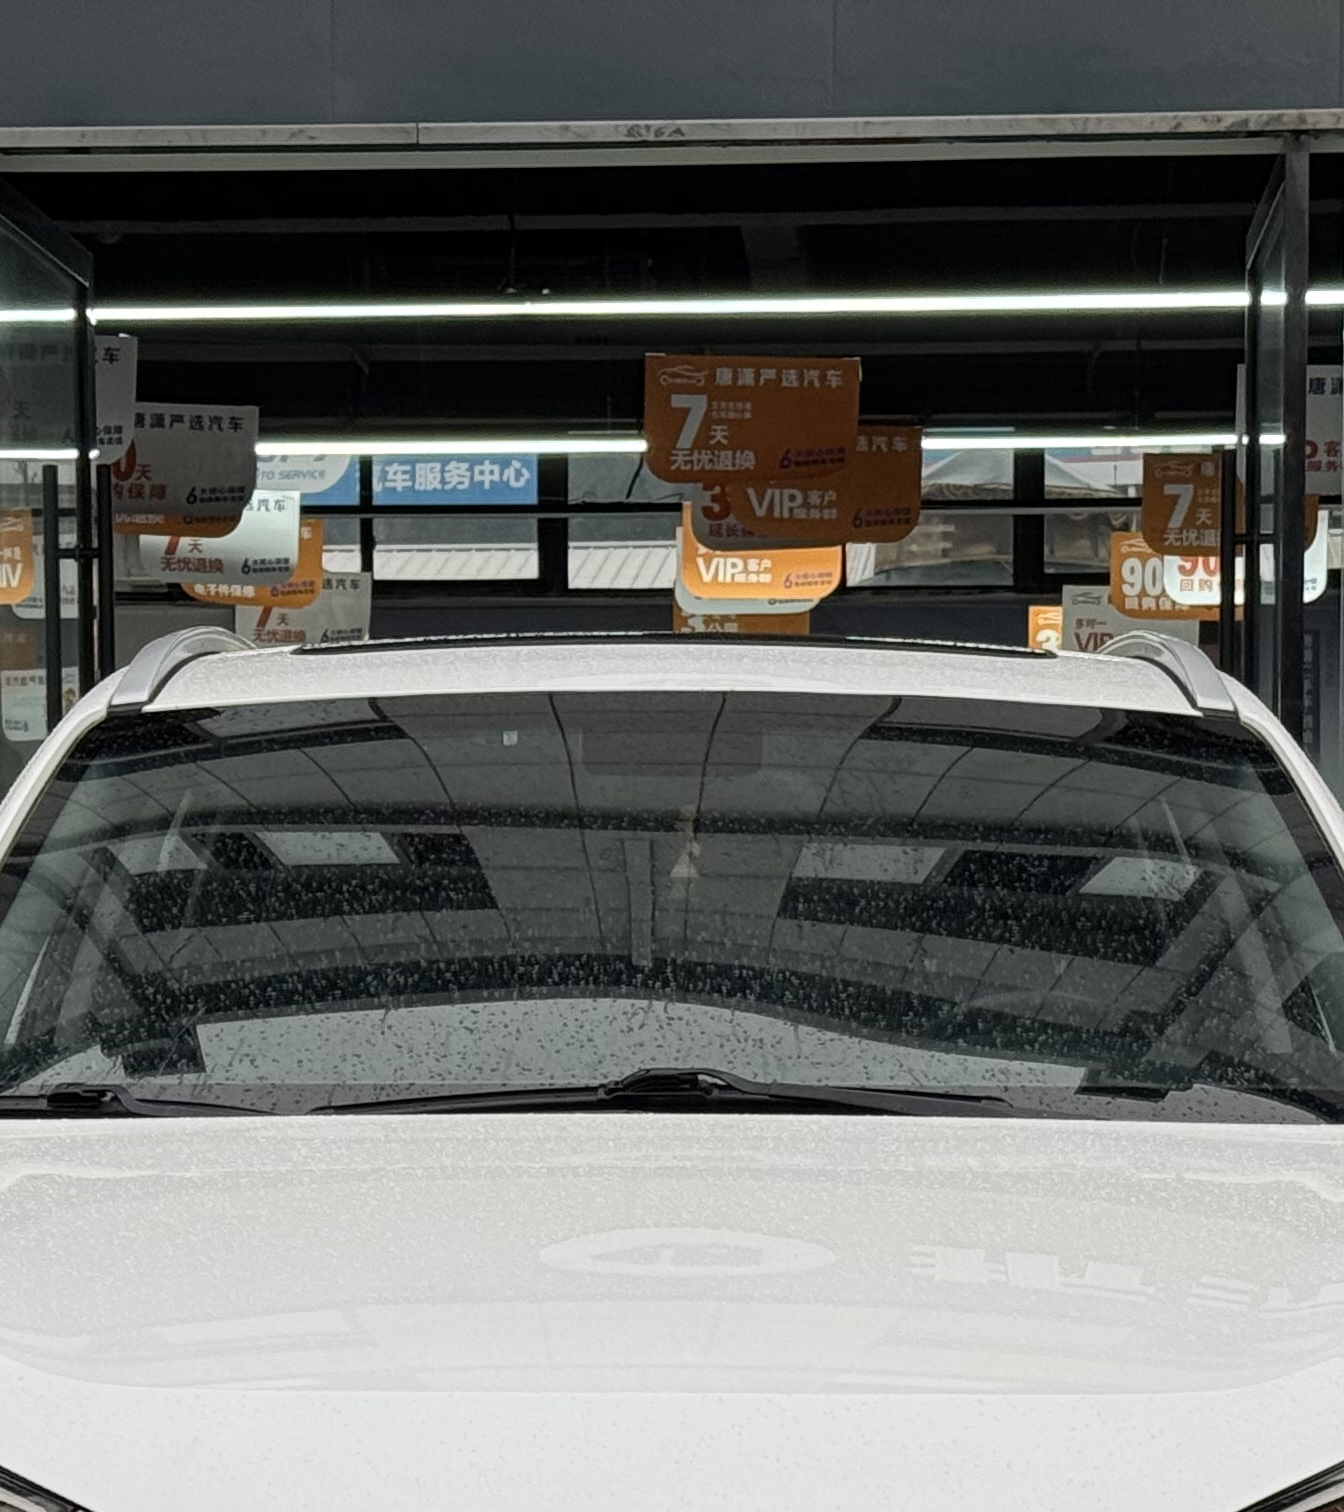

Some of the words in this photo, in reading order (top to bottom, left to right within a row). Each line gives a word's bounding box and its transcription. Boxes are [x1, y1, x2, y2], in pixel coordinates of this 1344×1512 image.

[714, 367, 845, 389] 唐潇严选汽车
[669, 450, 755, 472] 无忧退换
[278, 469, 326, 480] SERVICE
[747, 487, 803, 519] VIP
[807, 489, 837, 506] 客户
[708, 522, 763, 539] 延长保
[1163, 529, 1221, 547] 无忧退
[696, 558, 746, 584] VIP
